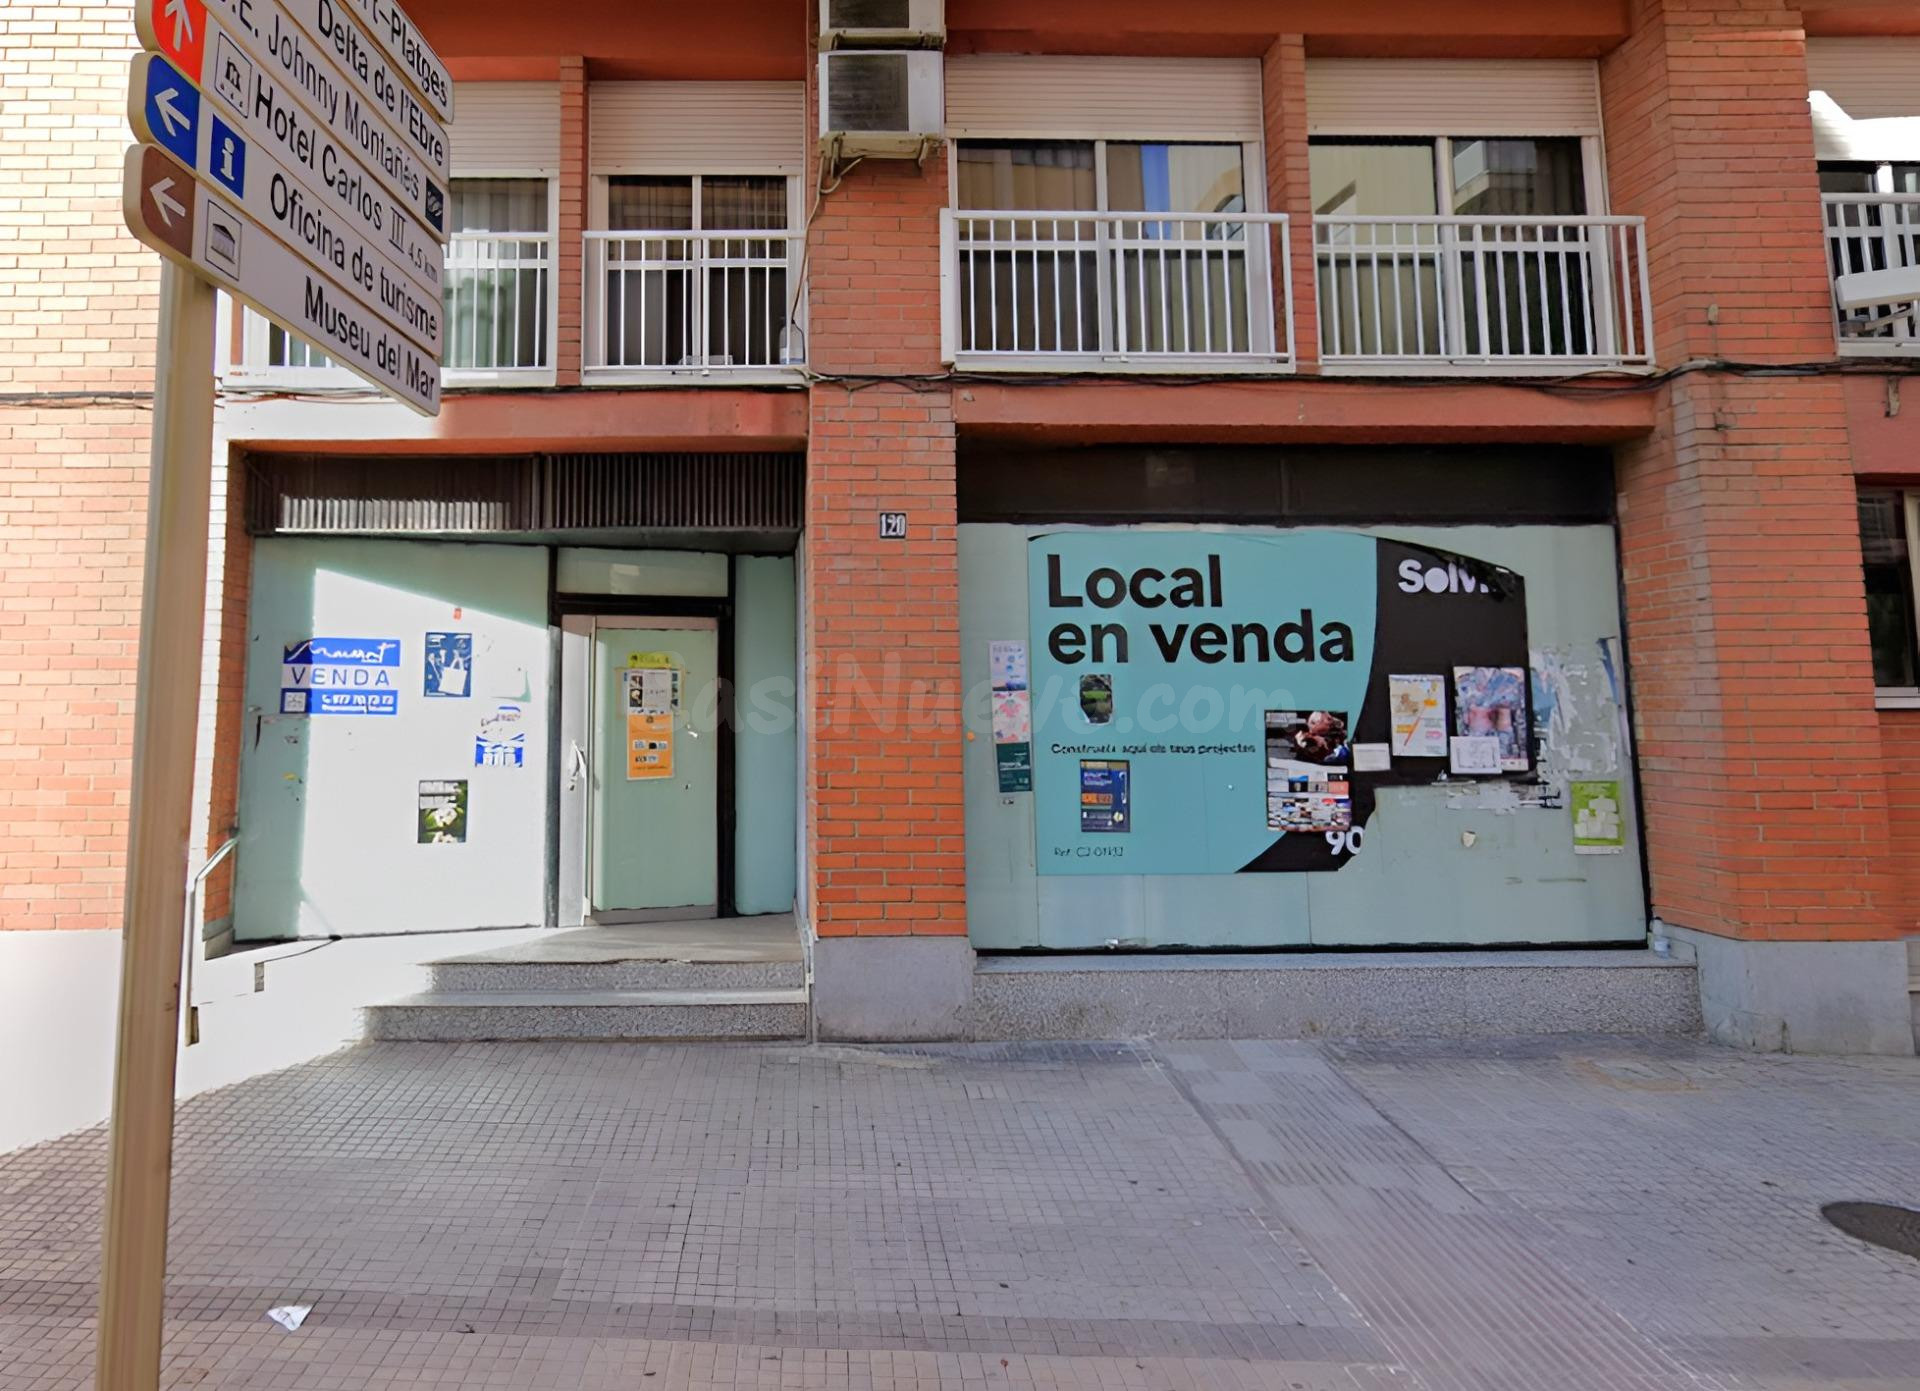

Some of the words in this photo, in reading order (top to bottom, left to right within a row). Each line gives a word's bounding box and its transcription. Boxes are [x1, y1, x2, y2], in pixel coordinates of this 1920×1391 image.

[268, 14, 338, 125] Johnny
[345, 91, 419, 200] Montañés
[318, 0, 368, 84] Delta
[375, 65, 395, 112] de
[400, 88, 443, 166] l'Ebre
[255, 75, 315, 170] Hotel
[322, 144, 382, 230] Carlos
[389, 206, 407, 254] III
[271, 173, 345, 270] Oficina
[352, 246, 373, 291] de
[380, 267, 437, 341] turisme
[305, 275, 370, 359] Museu
[377, 333, 401, 380] del
[406, 350, 435, 400] Mar
[881, 513, 906, 537] 120
[1047, 554, 1223, 609] Local
[291, 666, 390, 686] VENDA
[1048, 622, 1129, 664] en
[1148, 608, 1354, 664] venda
